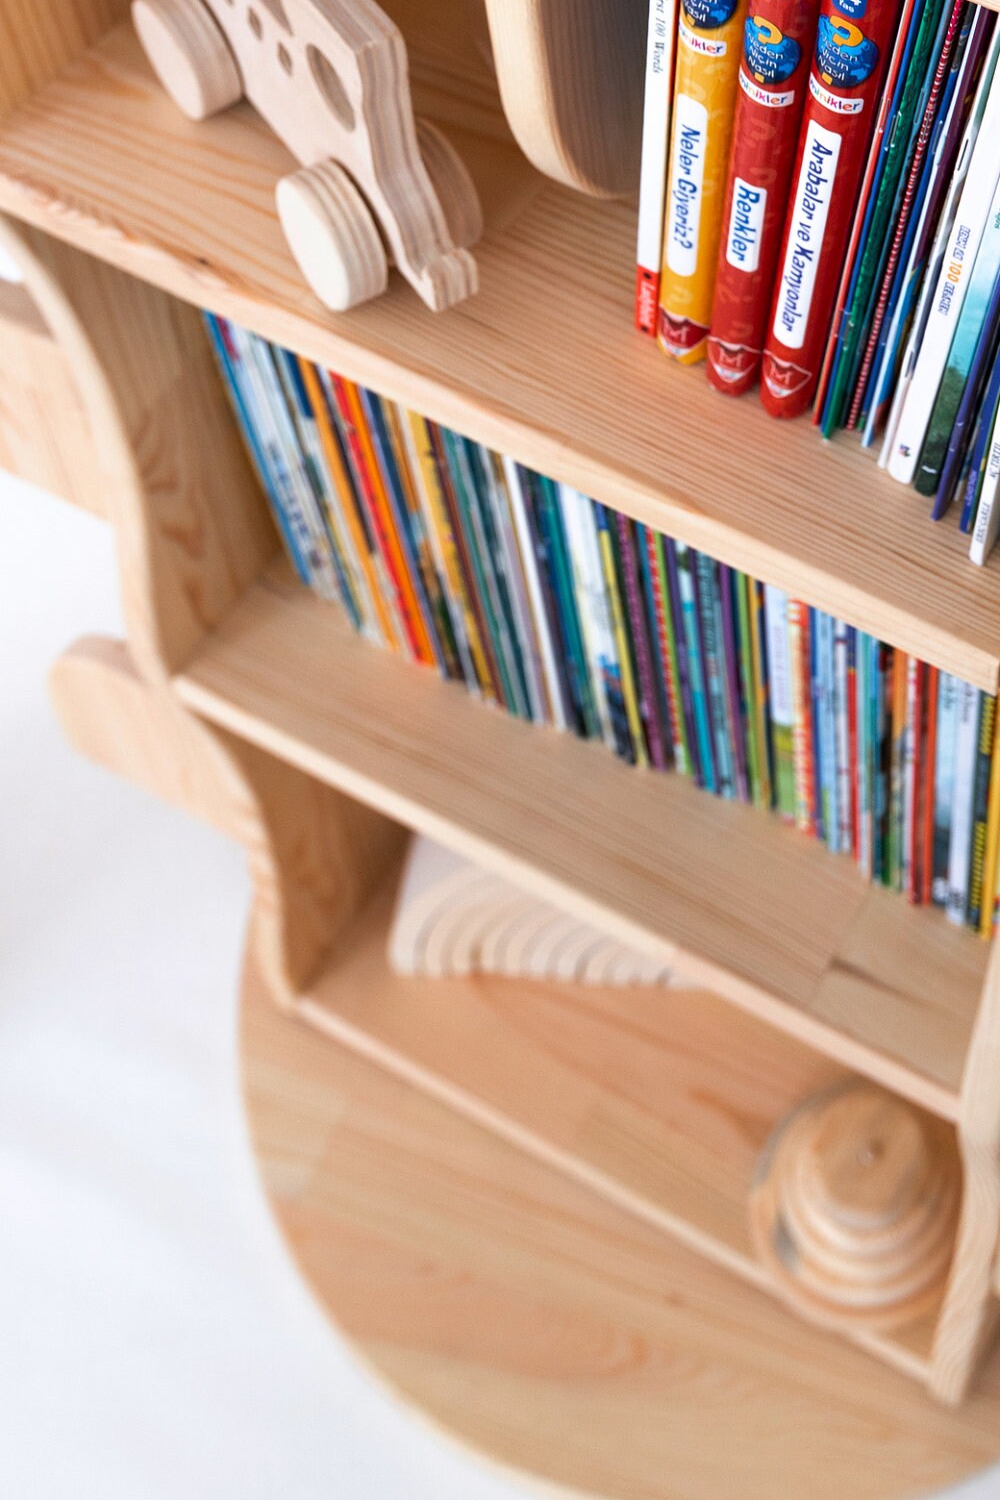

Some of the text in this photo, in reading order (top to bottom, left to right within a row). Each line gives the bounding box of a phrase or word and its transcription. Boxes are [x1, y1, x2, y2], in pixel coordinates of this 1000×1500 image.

[655, 17, 666, 37] 100
[653, 41, 664, 74] Words
[747, 33, 784, 60] Neden
[748, 45, 777, 69] Niçin
[820, 31, 858, 62] Neden
[821, 45, 849, 72] Niçin
[748, 56, 774, 78] Nasıl
[818, 55, 845, 81] Nasıl
[672, 124, 701, 250] Neler Giyeriz?
[731, 185, 760, 262] Renkler
[782, 137, 833, 333] Arabalar ve Kamyonlar
[947, 261, 963, 283] 100
